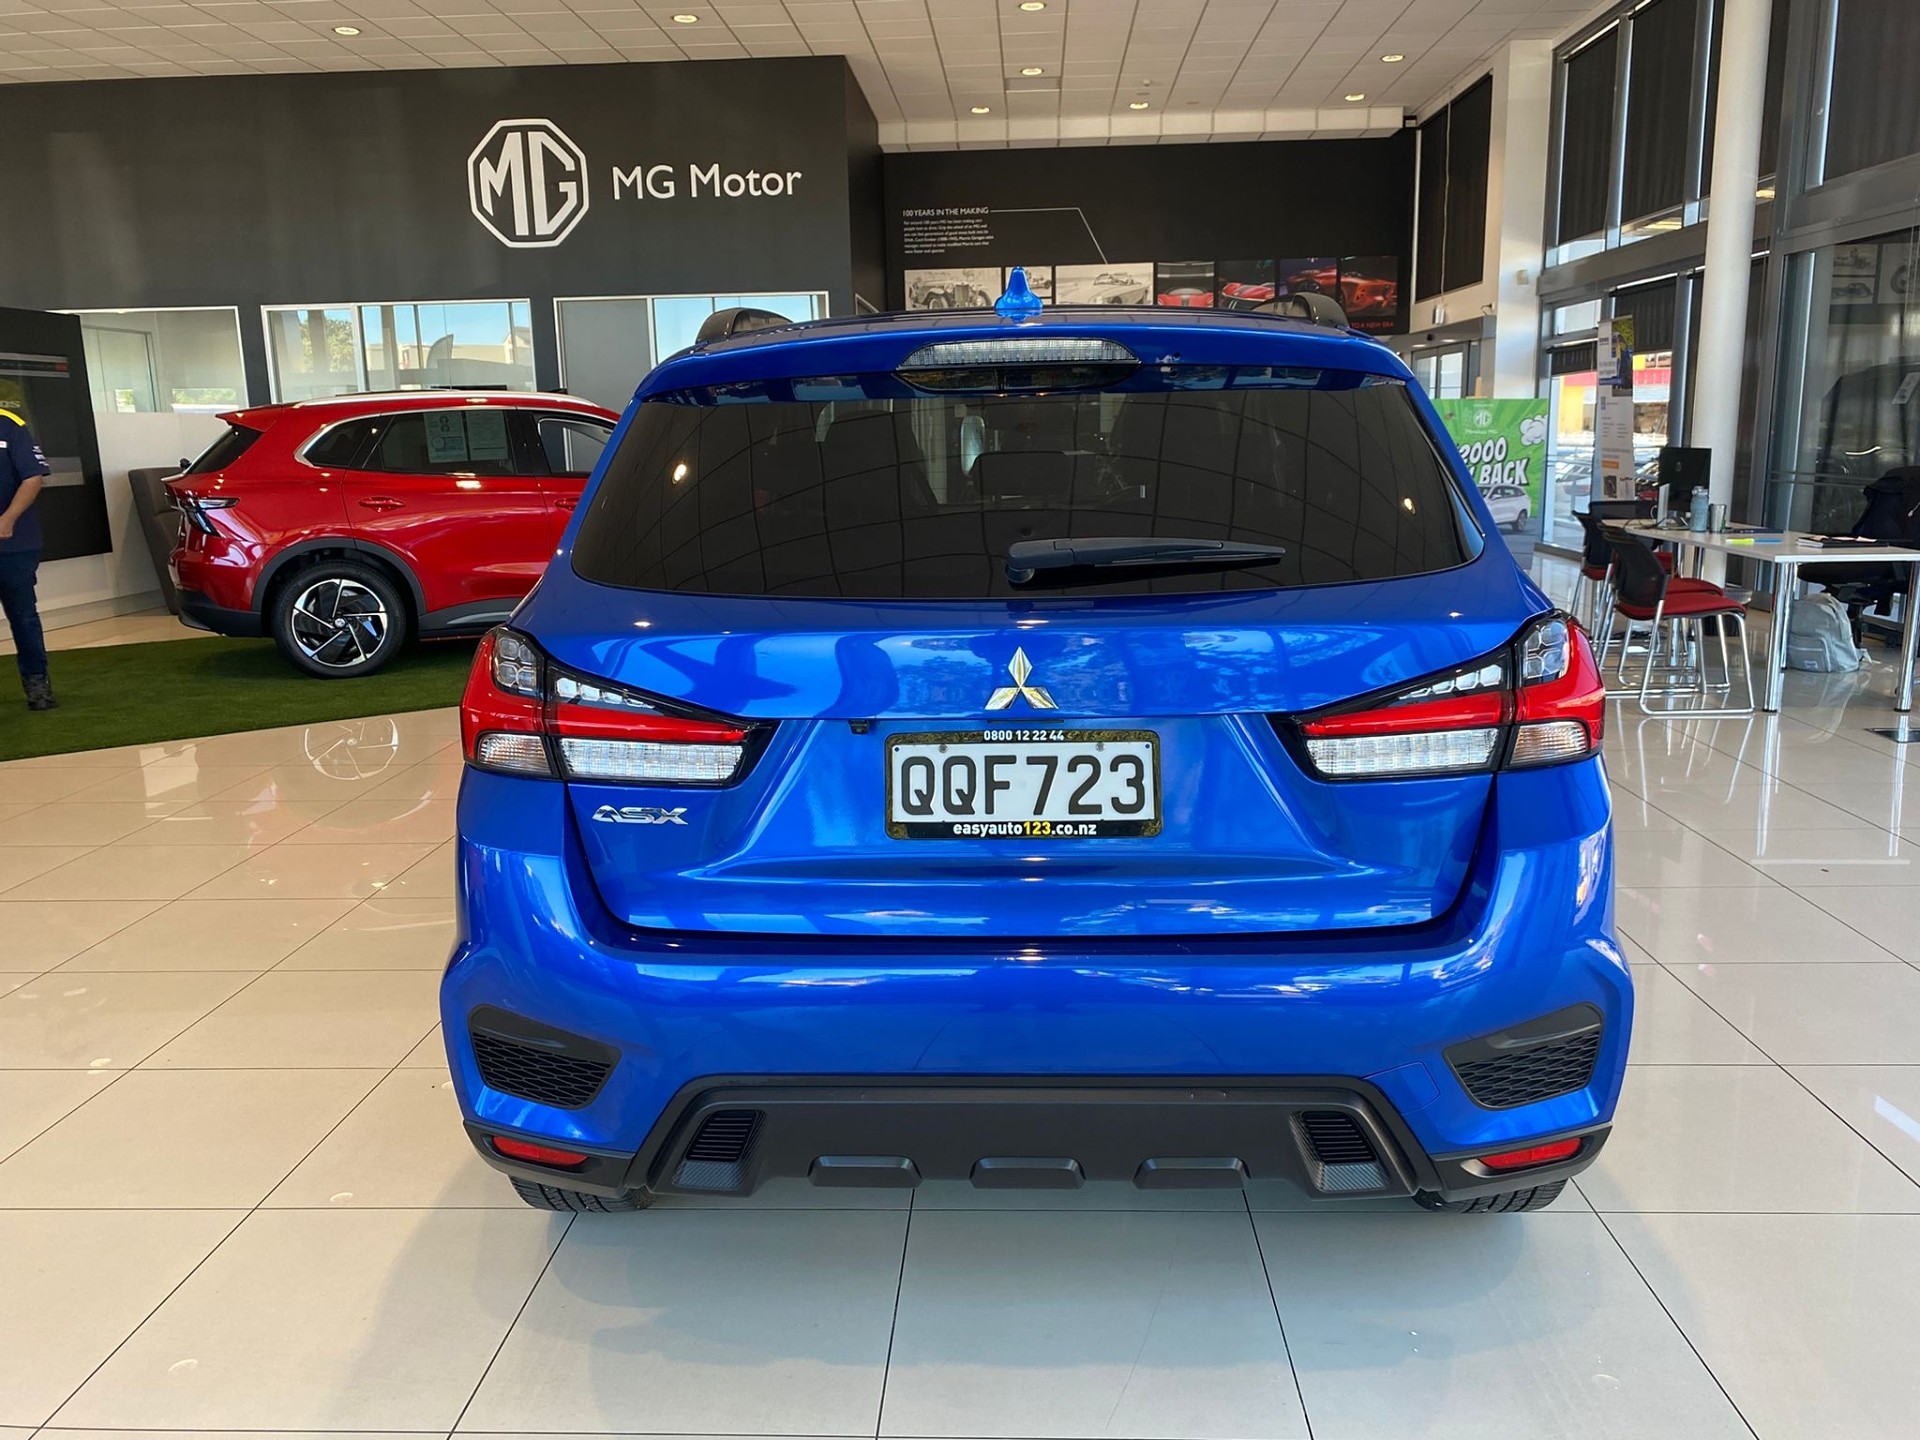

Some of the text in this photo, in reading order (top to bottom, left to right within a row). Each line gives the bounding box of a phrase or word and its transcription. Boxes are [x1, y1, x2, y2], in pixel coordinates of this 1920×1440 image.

[479, 131, 577, 235] MG
[612, 163, 802, 200] MG Motor
[903, 206, 989, 217] 100 YEARS IN THE MAKING
[1478, 458, 1529, 486] BACK
[983, 729, 1065, 741] 0800 12 22 44
[901, 754, 1146, 816] QQF723
[592, 804, 689, 825] ASX
[952, 822, 1098, 838] easyauto123.co.nz
